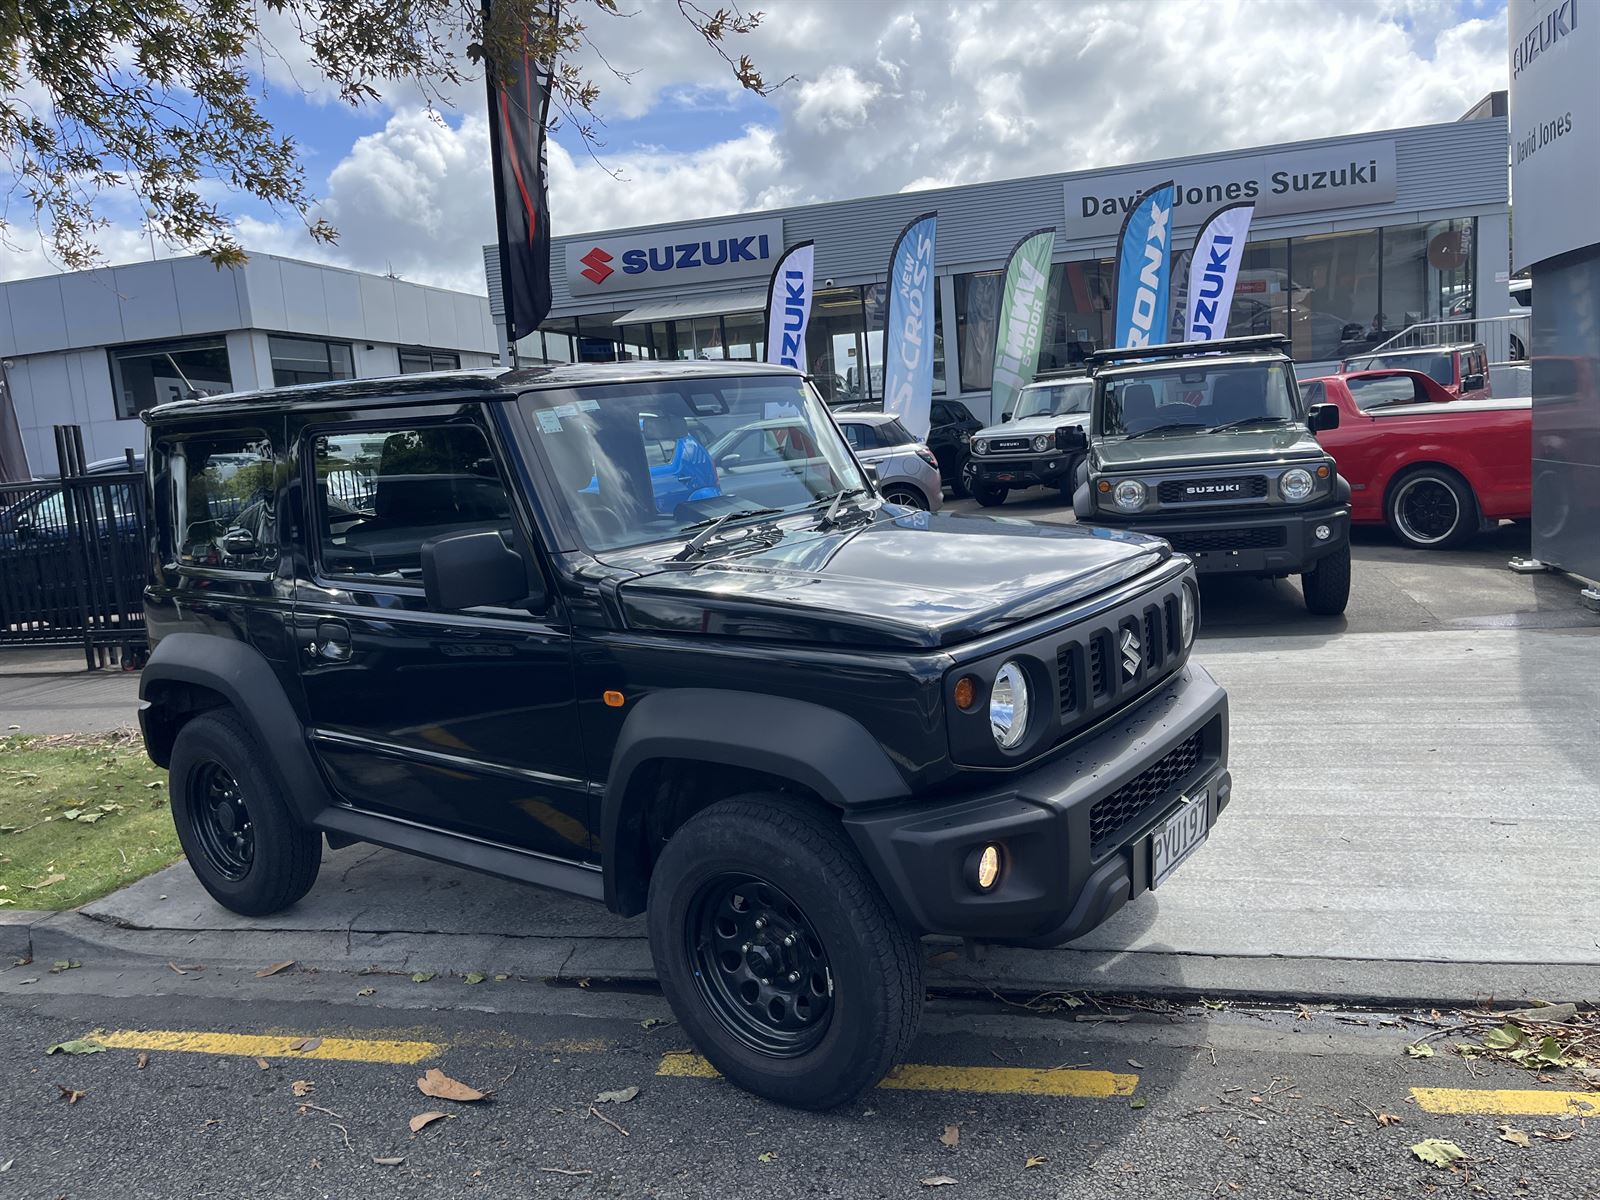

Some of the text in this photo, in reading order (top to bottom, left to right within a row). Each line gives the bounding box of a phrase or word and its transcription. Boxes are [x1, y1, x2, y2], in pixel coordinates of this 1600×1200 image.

[1513, 0, 1578, 80] SUZUKI
[1516, 111, 1572, 165] David Jones
[1082, 159, 1378, 218] Dav Jones Suzuki
[621, 234, 770, 275] SUZUKI
[900, 252, 915, 300] NEW
[1126, 200, 1170, 349] RONX
[1190, 235, 1234, 343] UZUKI
[1186, 484, 1240, 494] SUZUKI
[1153, 798, 1206, 877] PYU197
